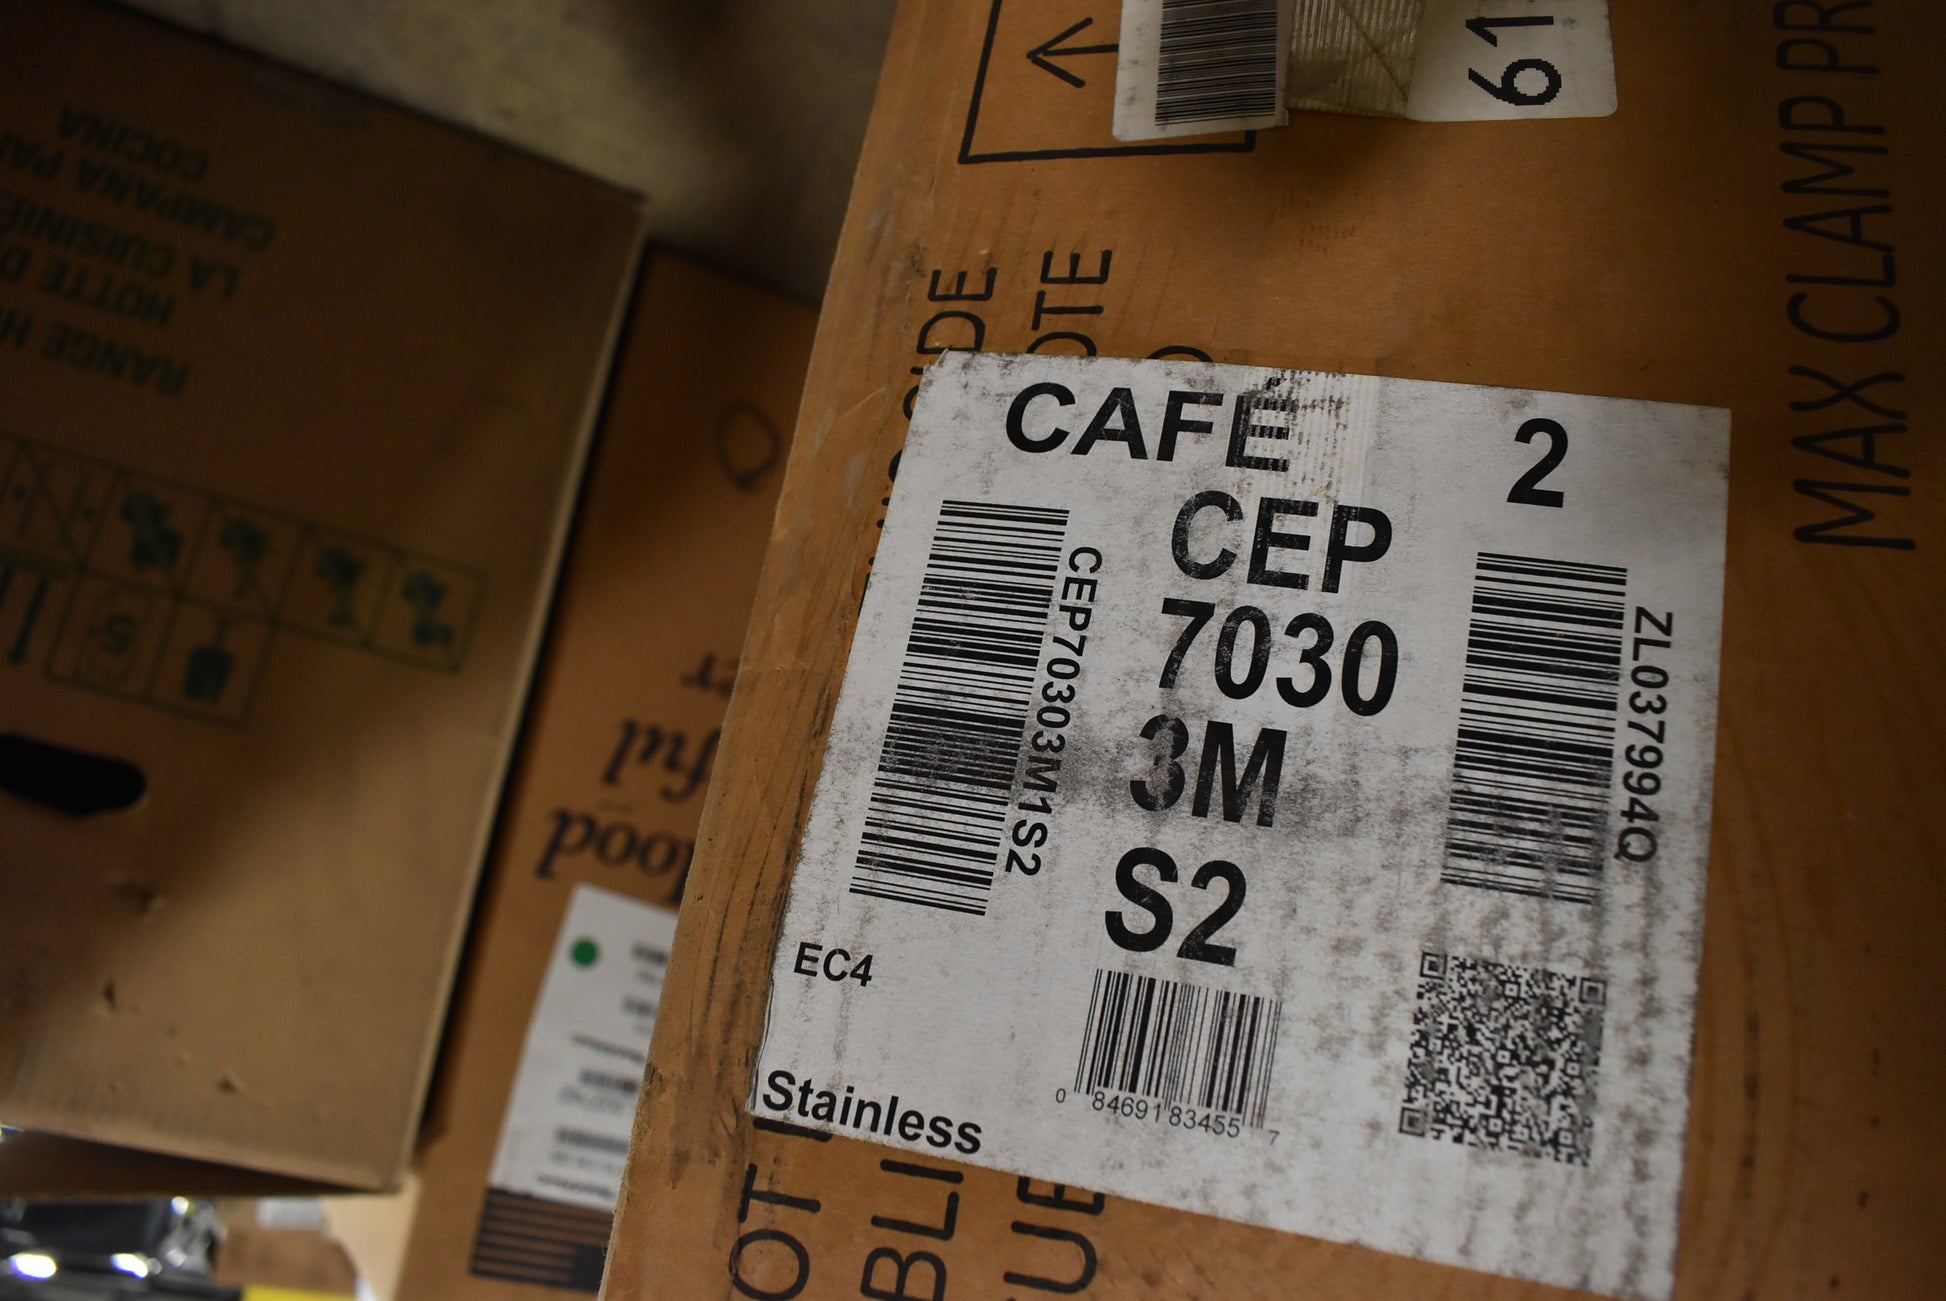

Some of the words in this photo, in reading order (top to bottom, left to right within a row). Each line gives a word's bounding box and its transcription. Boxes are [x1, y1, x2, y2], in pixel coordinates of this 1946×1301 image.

[1465, 15, 1562, 106] 61
[59, 105, 211, 183] COCINA
[79, 158, 275, 252] CAMPANA
[1778, 95, 1900, 343] CLAMP
[43, 257, 176, 328] HOTTE
[187, 259, 241, 298] LA
[0, 308, 32, 349] H
[41, 321, 190, 398] RANGE
[1506, 418, 1569, 508] 2
[1789, 366, 1915, 550] MAX
[1171, 490, 1392, 594] CEP
[1158, 597, 1399, 717] 7030
[1004, 546, 1102, 876] CEP70303M1S2
[1613, 606, 1673, 863] ZL037994Q
[1129, 713, 1288, 828] 3M
[1105, 847, 1247, 967] S2
[793, 941, 873, 987] EC4
[762, 1070, 982, 1154] Stainless
[1004, 1175, 1105, 1301] UE
